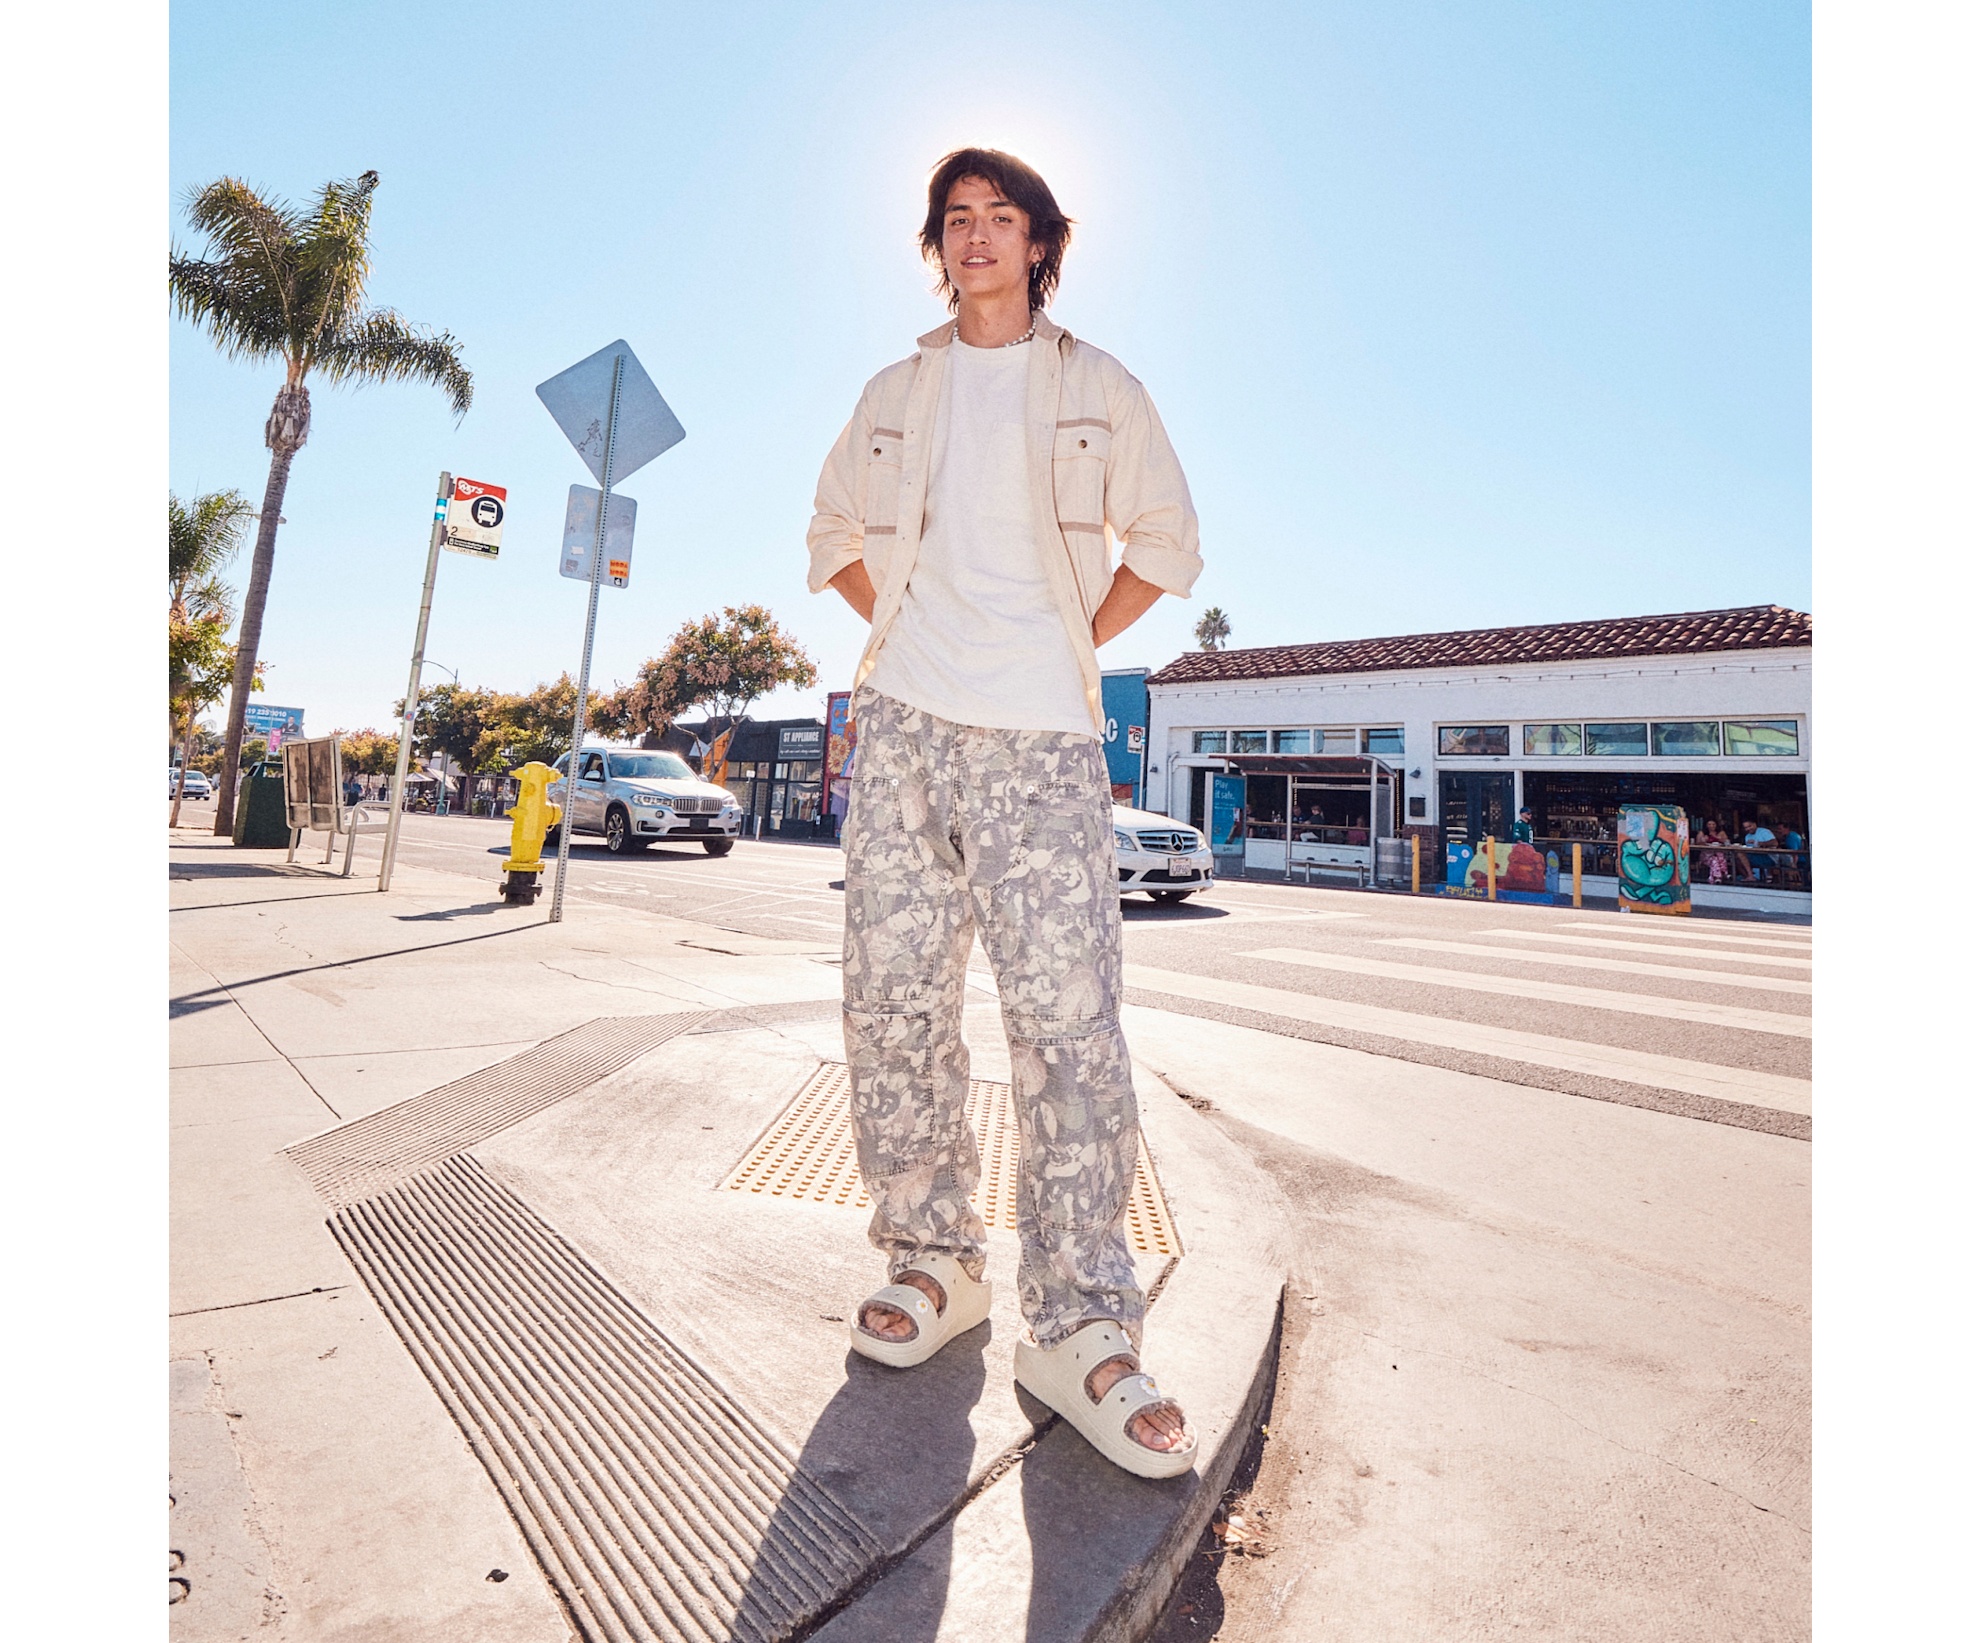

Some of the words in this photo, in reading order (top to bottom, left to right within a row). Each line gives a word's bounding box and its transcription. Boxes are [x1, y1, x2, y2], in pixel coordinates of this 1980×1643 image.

[450, 526, 459, 536] 2
[791, 731, 819, 743] APPLIANCE
[1215, 779, 1229, 790] Play
